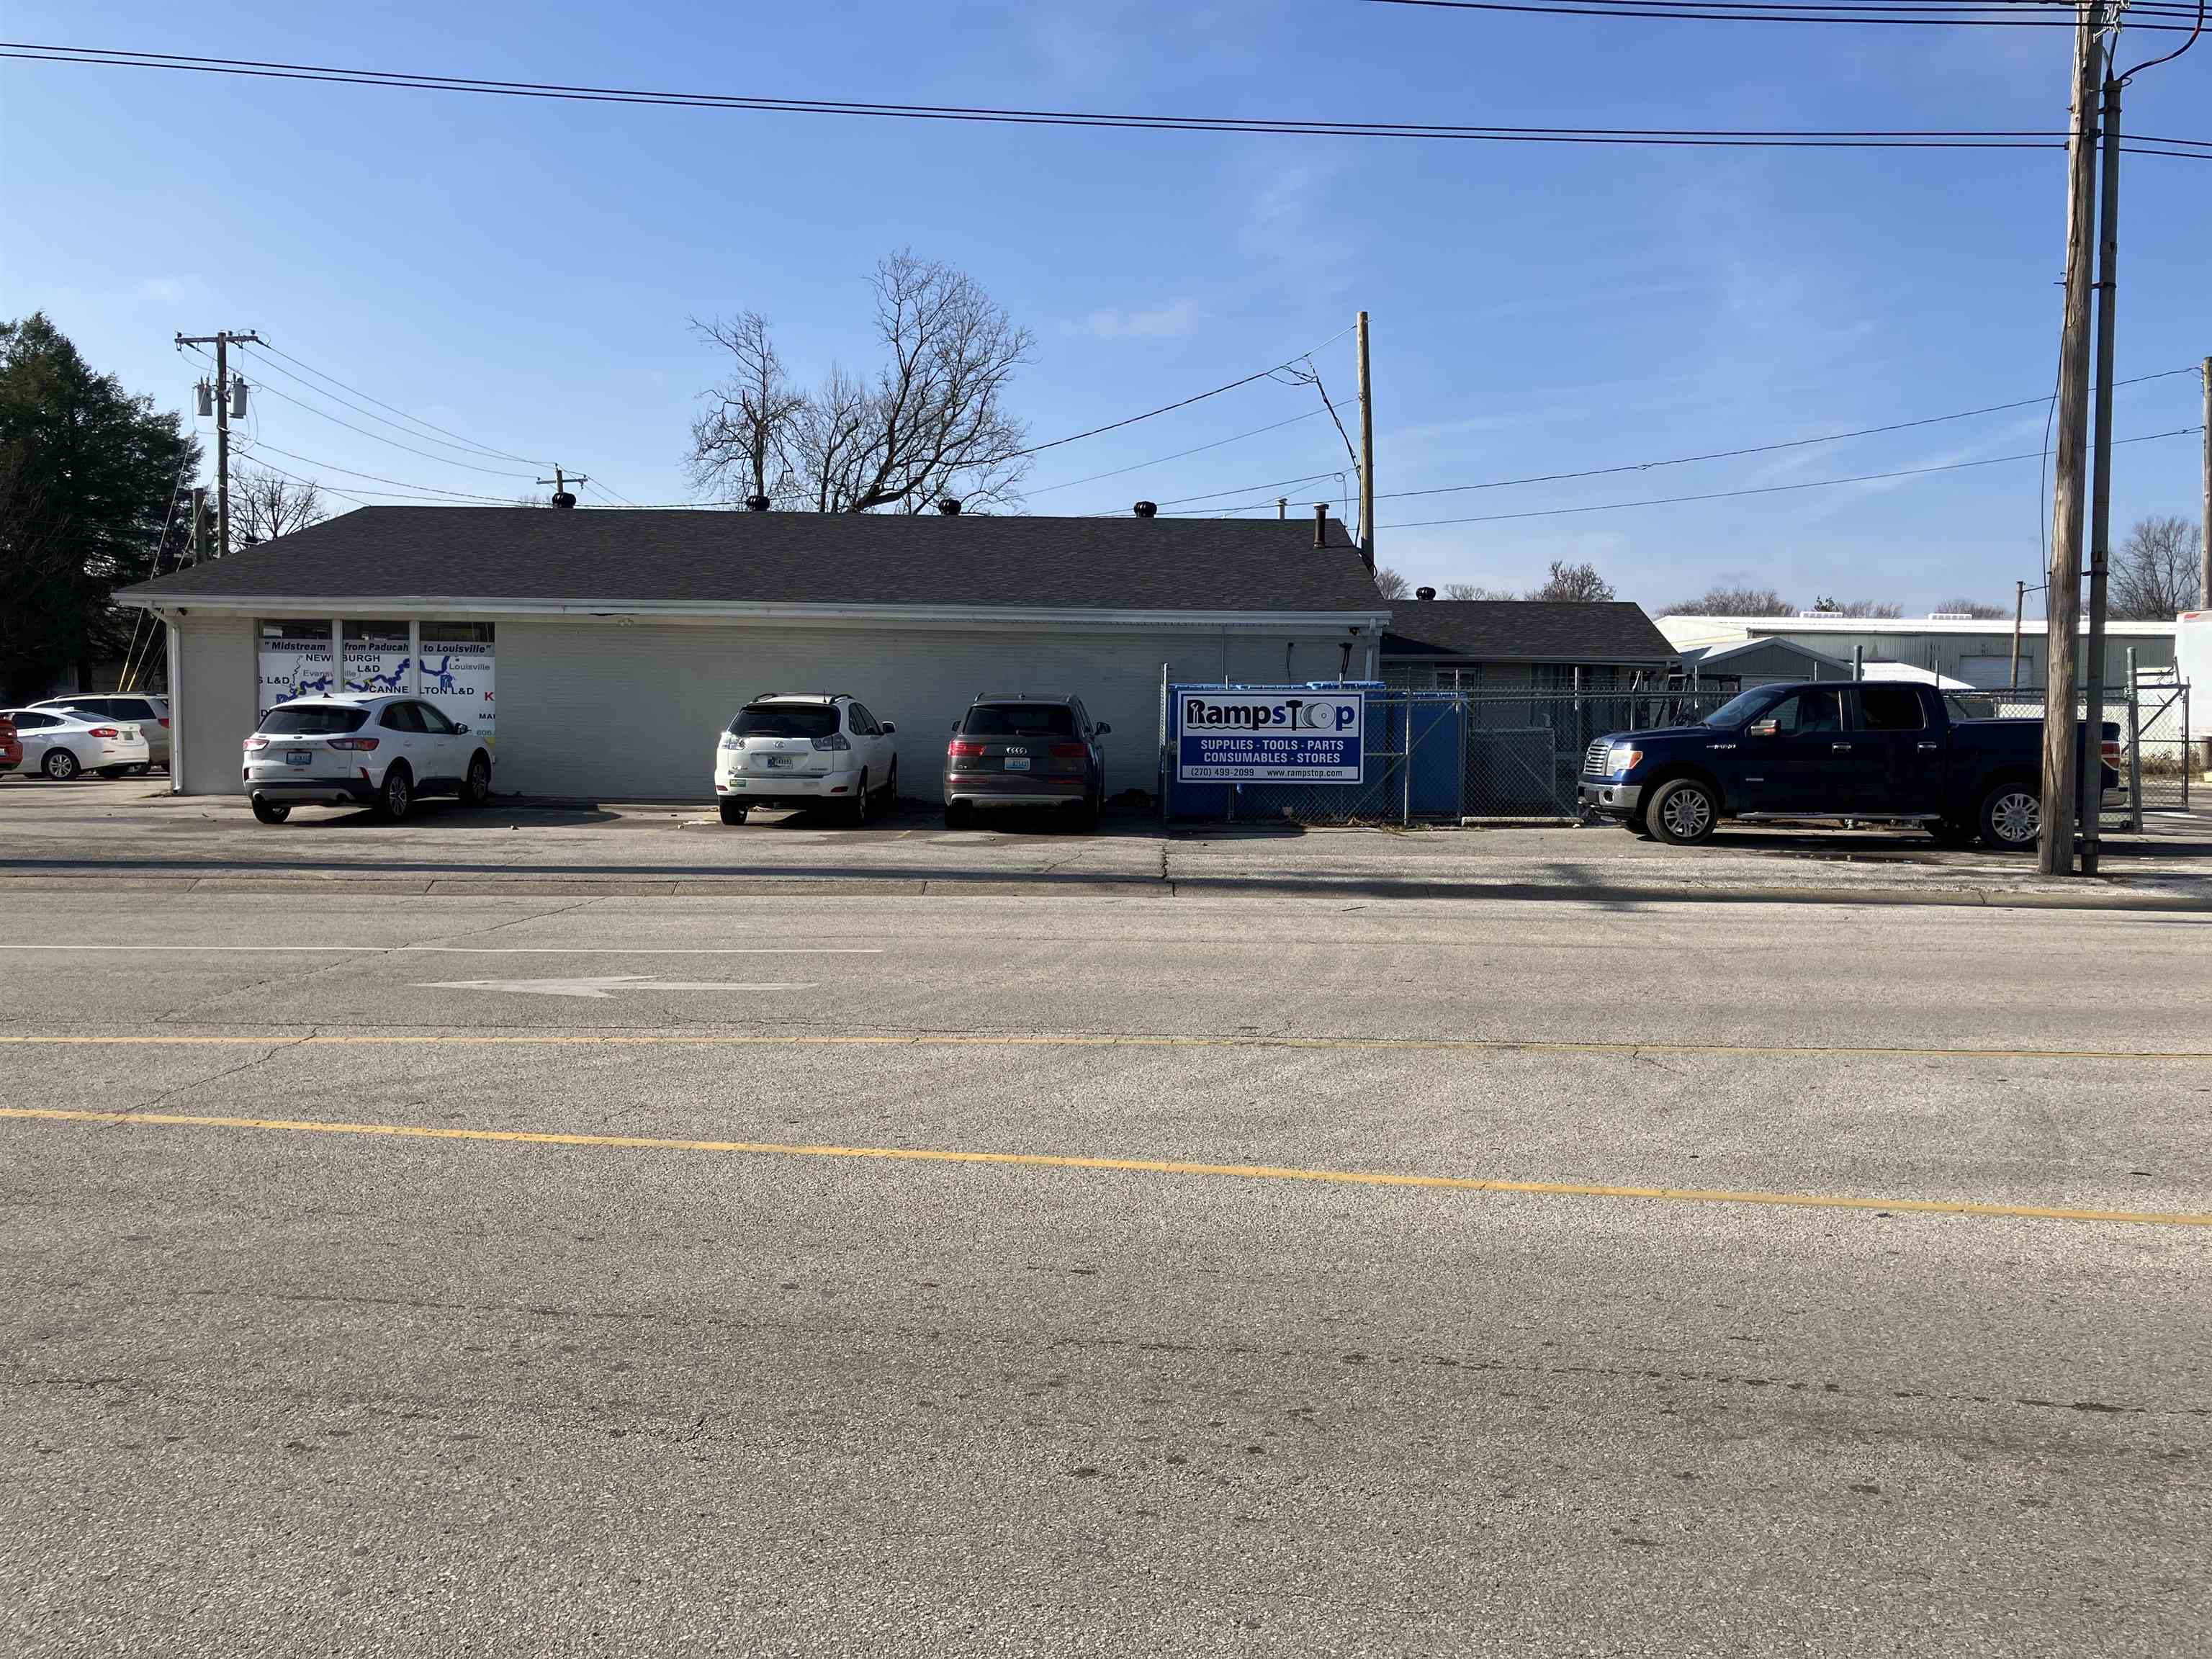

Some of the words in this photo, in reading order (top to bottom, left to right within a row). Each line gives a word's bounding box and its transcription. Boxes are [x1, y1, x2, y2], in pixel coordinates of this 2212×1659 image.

[344, 642, 366, 651] from
[369, 643, 409, 652] Paducah
[451, 687, 475, 696] L&D
[1200, 739, 1254, 750] SUPPLIES
[1262, 740, 1298, 750] TOOLS
[1307, 740, 1344, 750] PARTS
[1203, 752, 1287, 763] CONSUMABLES
[1297, 752, 1341, 763] STORES
[1190, 768, 1212, 777] (270)
[1214, 768, 1255, 776] 499-2099
[1267, 768, 1343, 778] www.rampstop.com
